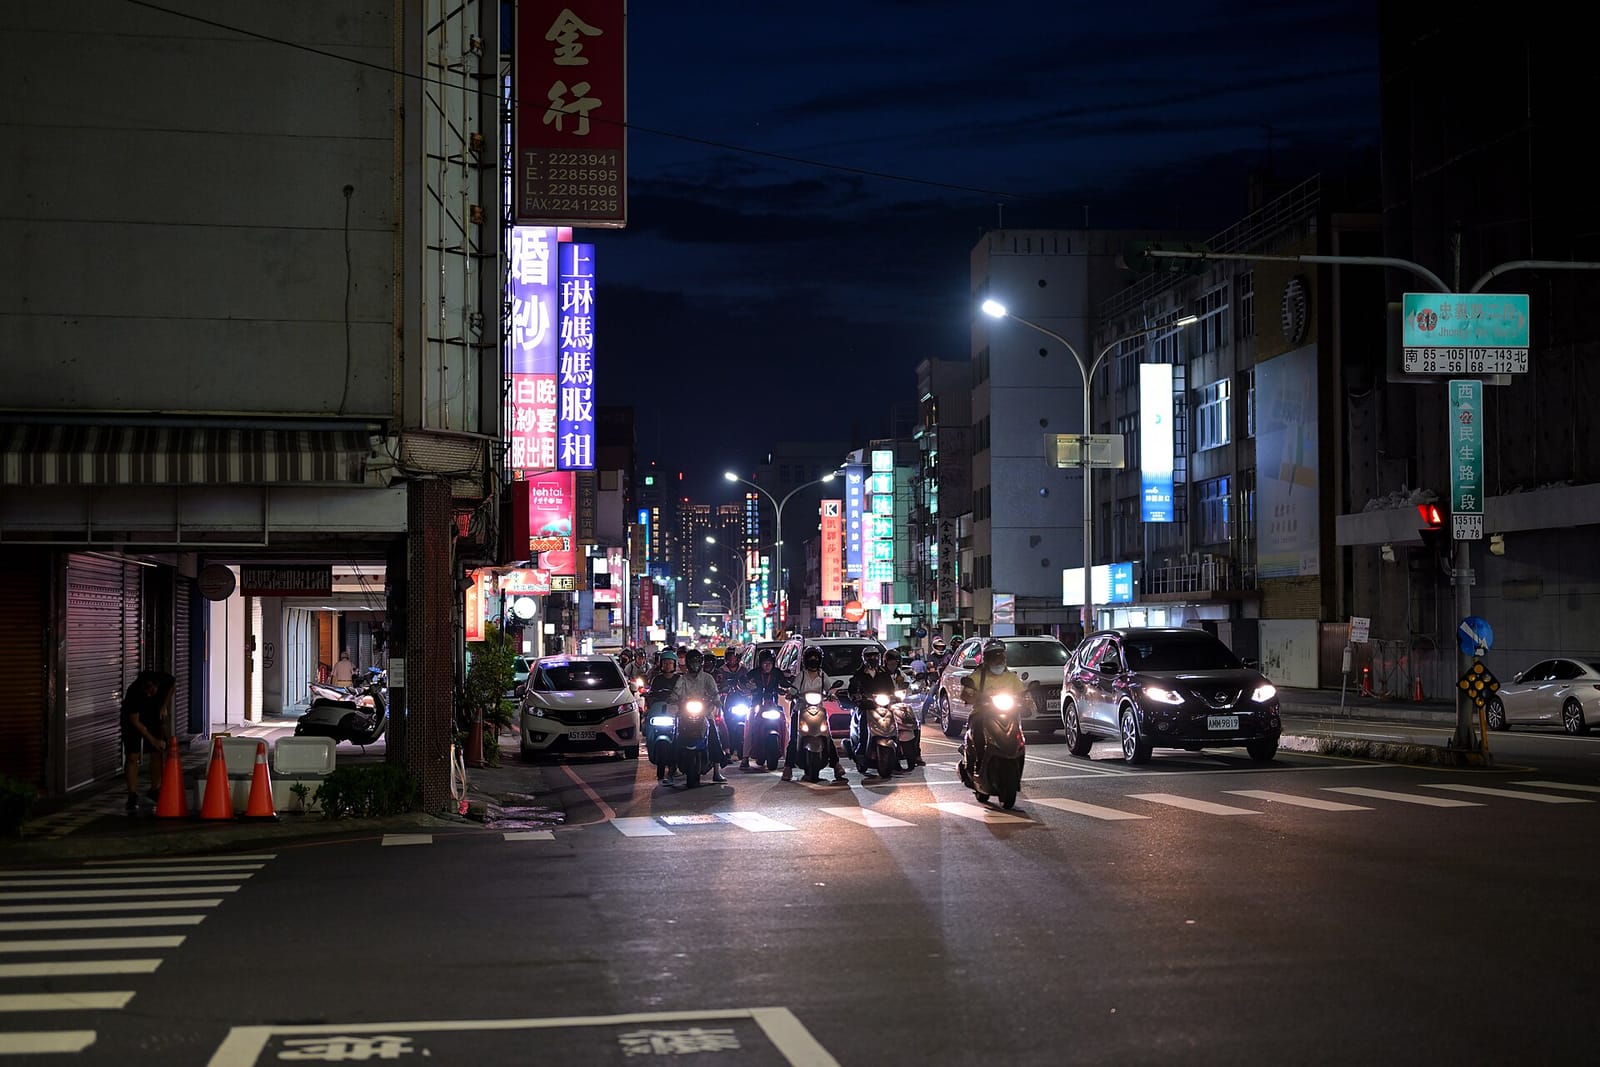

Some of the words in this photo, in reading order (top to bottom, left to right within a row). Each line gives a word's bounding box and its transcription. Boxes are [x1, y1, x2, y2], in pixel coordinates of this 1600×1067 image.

[542, 8, 604, 136] 金行
[549, 153, 617, 166] 2223941
[549, 168, 618, 182] 2285595
[549, 183, 618, 197] 2285596
[508, 229, 551, 351] 婚紗
[1405, 349, 1419, 363] 南
[1514, 349, 1527, 364] 北
[1458, 383, 1473, 400] 西
[1459, 426, 1476, 511] 民生路一段
[1456, 529, 1466, 539] 67
[1470, 529, 1480, 539] 78
